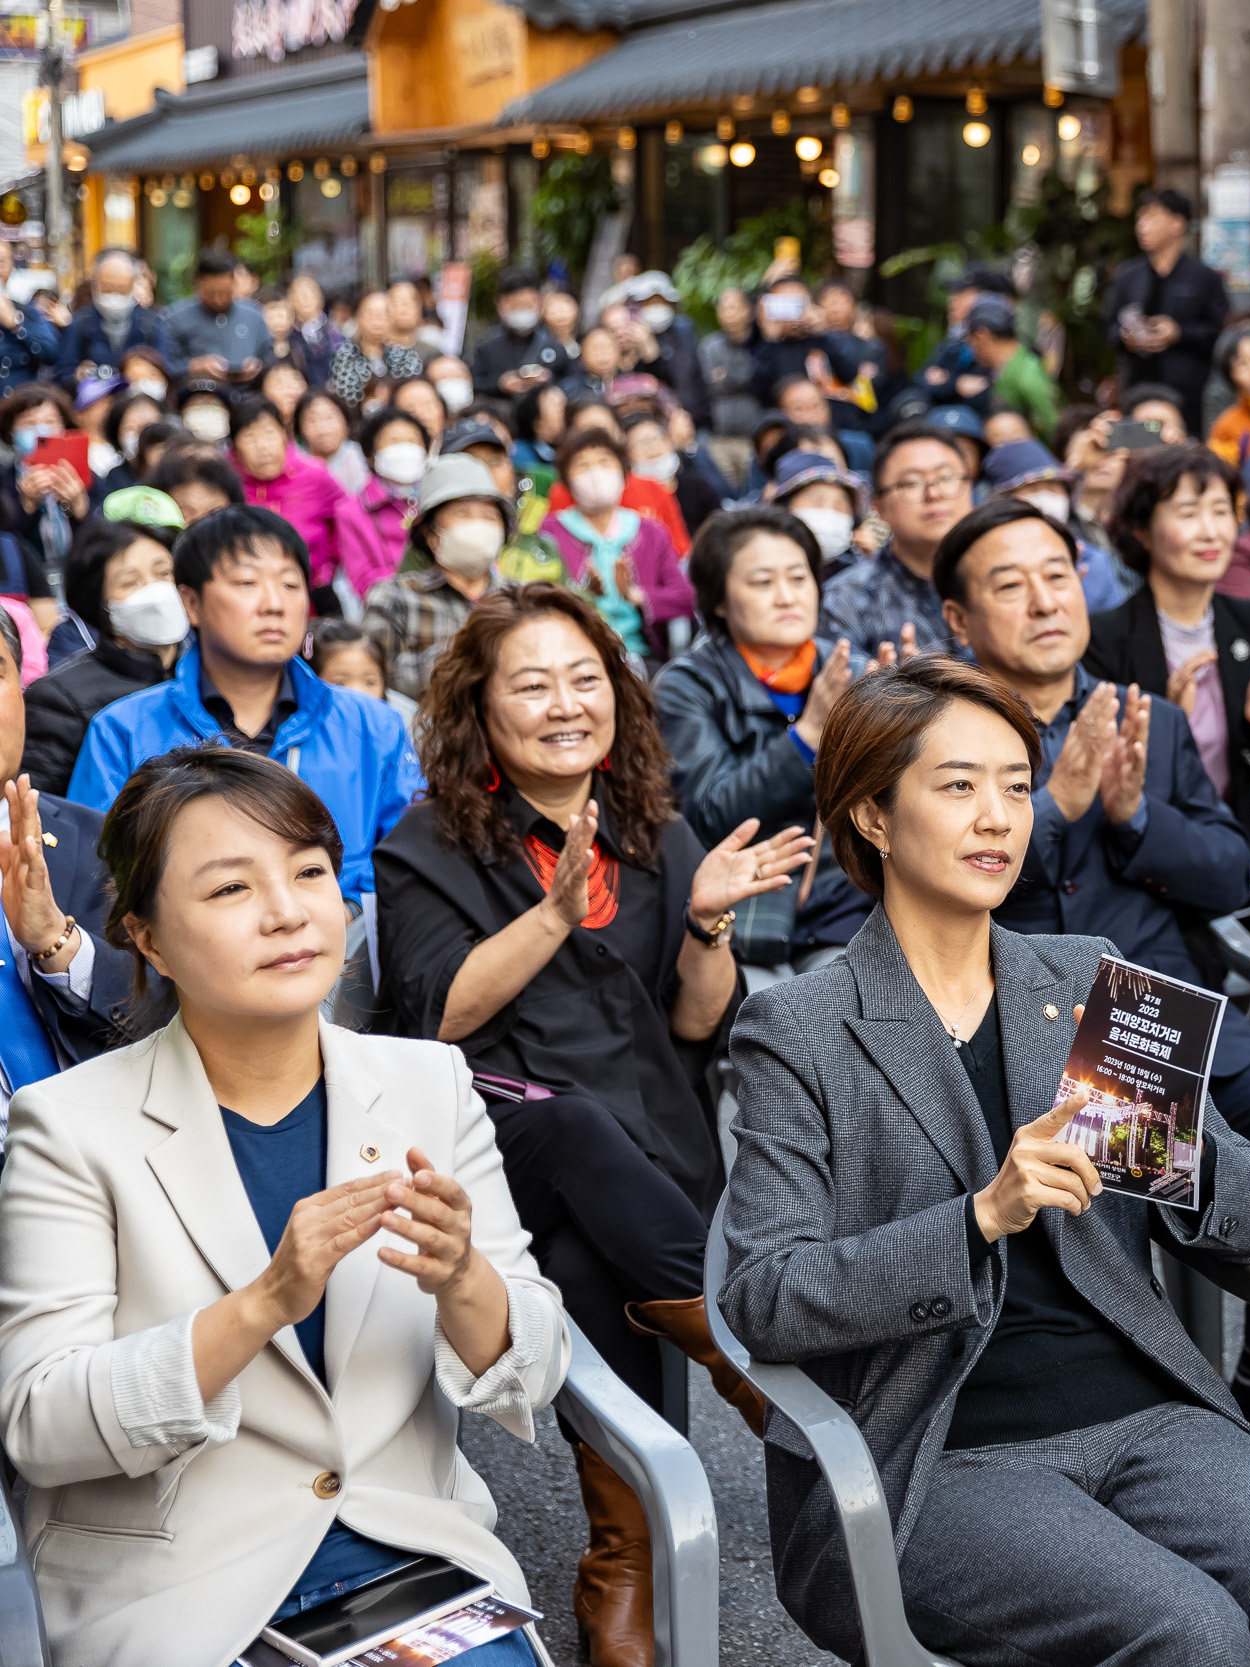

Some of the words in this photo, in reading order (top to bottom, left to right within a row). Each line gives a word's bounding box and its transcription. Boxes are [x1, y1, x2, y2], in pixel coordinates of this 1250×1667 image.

[1109, 1007, 1182, 1045] 건대양꼬치거리
[1138, 1003, 1160, 1018] 2023
[1109, 1026, 1172, 1060] 음식문화축제
[1096, 1064, 1113, 1076] 16:00
[1118, 1073, 1136, 1085] 18:00
[1135, 1079, 1166, 1096] 양꼬치거리
[1103, 1055, 1124, 1069] 2023년
[1123, 1062, 1137, 1075] 10월
[1137, 1067, 1151, 1080] 18일
[1150, 1072, 1163, 1084] (수)
